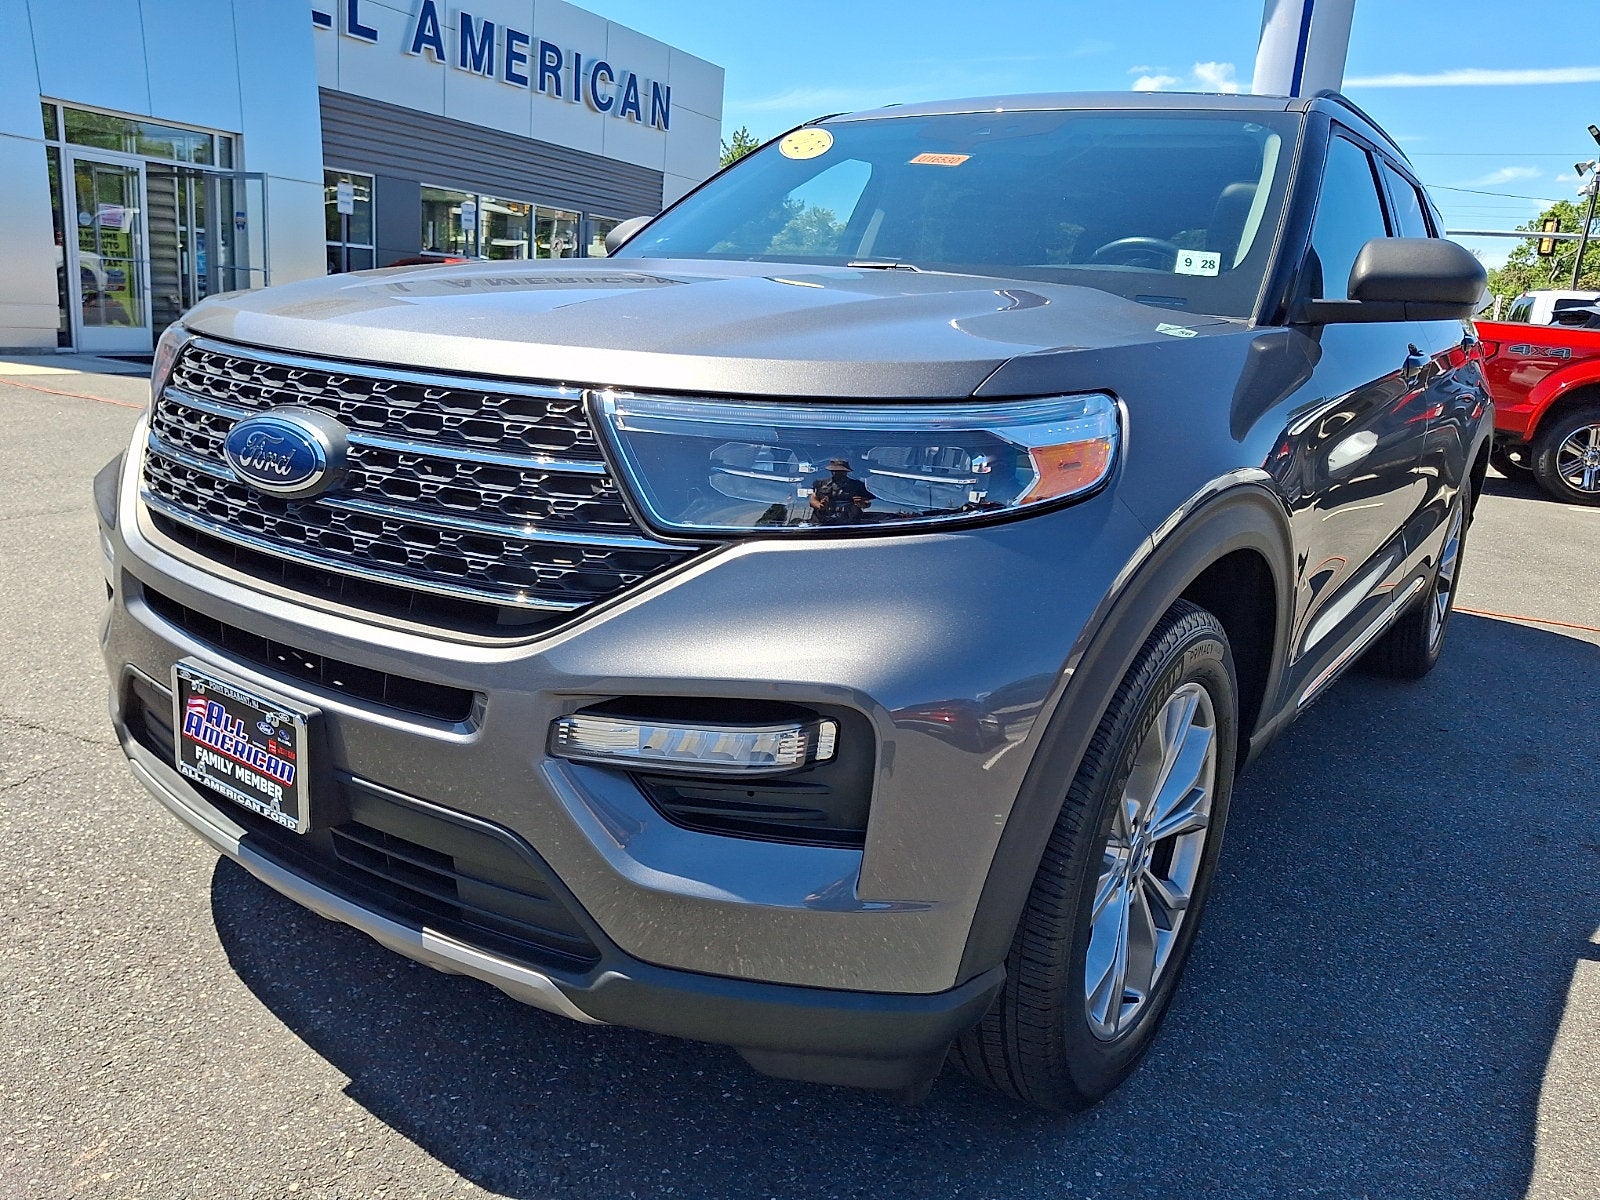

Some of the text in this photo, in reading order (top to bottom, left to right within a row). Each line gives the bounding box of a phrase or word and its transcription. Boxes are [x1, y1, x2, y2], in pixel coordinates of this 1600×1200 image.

[411, 0, 671, 131] AMERICAN
[1184, 257, 1216, 269] 9 28
[240, 431, 297, 475] Ford
[206, 700, 249, 741] ALL
[1126, 661, 1185, 773] MICHELIN
[184, 711, 296, 785] AMERICAN
[195, 745, 283, 801] FAMILY MEMBER
[182, 766, 297, 829] ALL AMERICAN FORD
